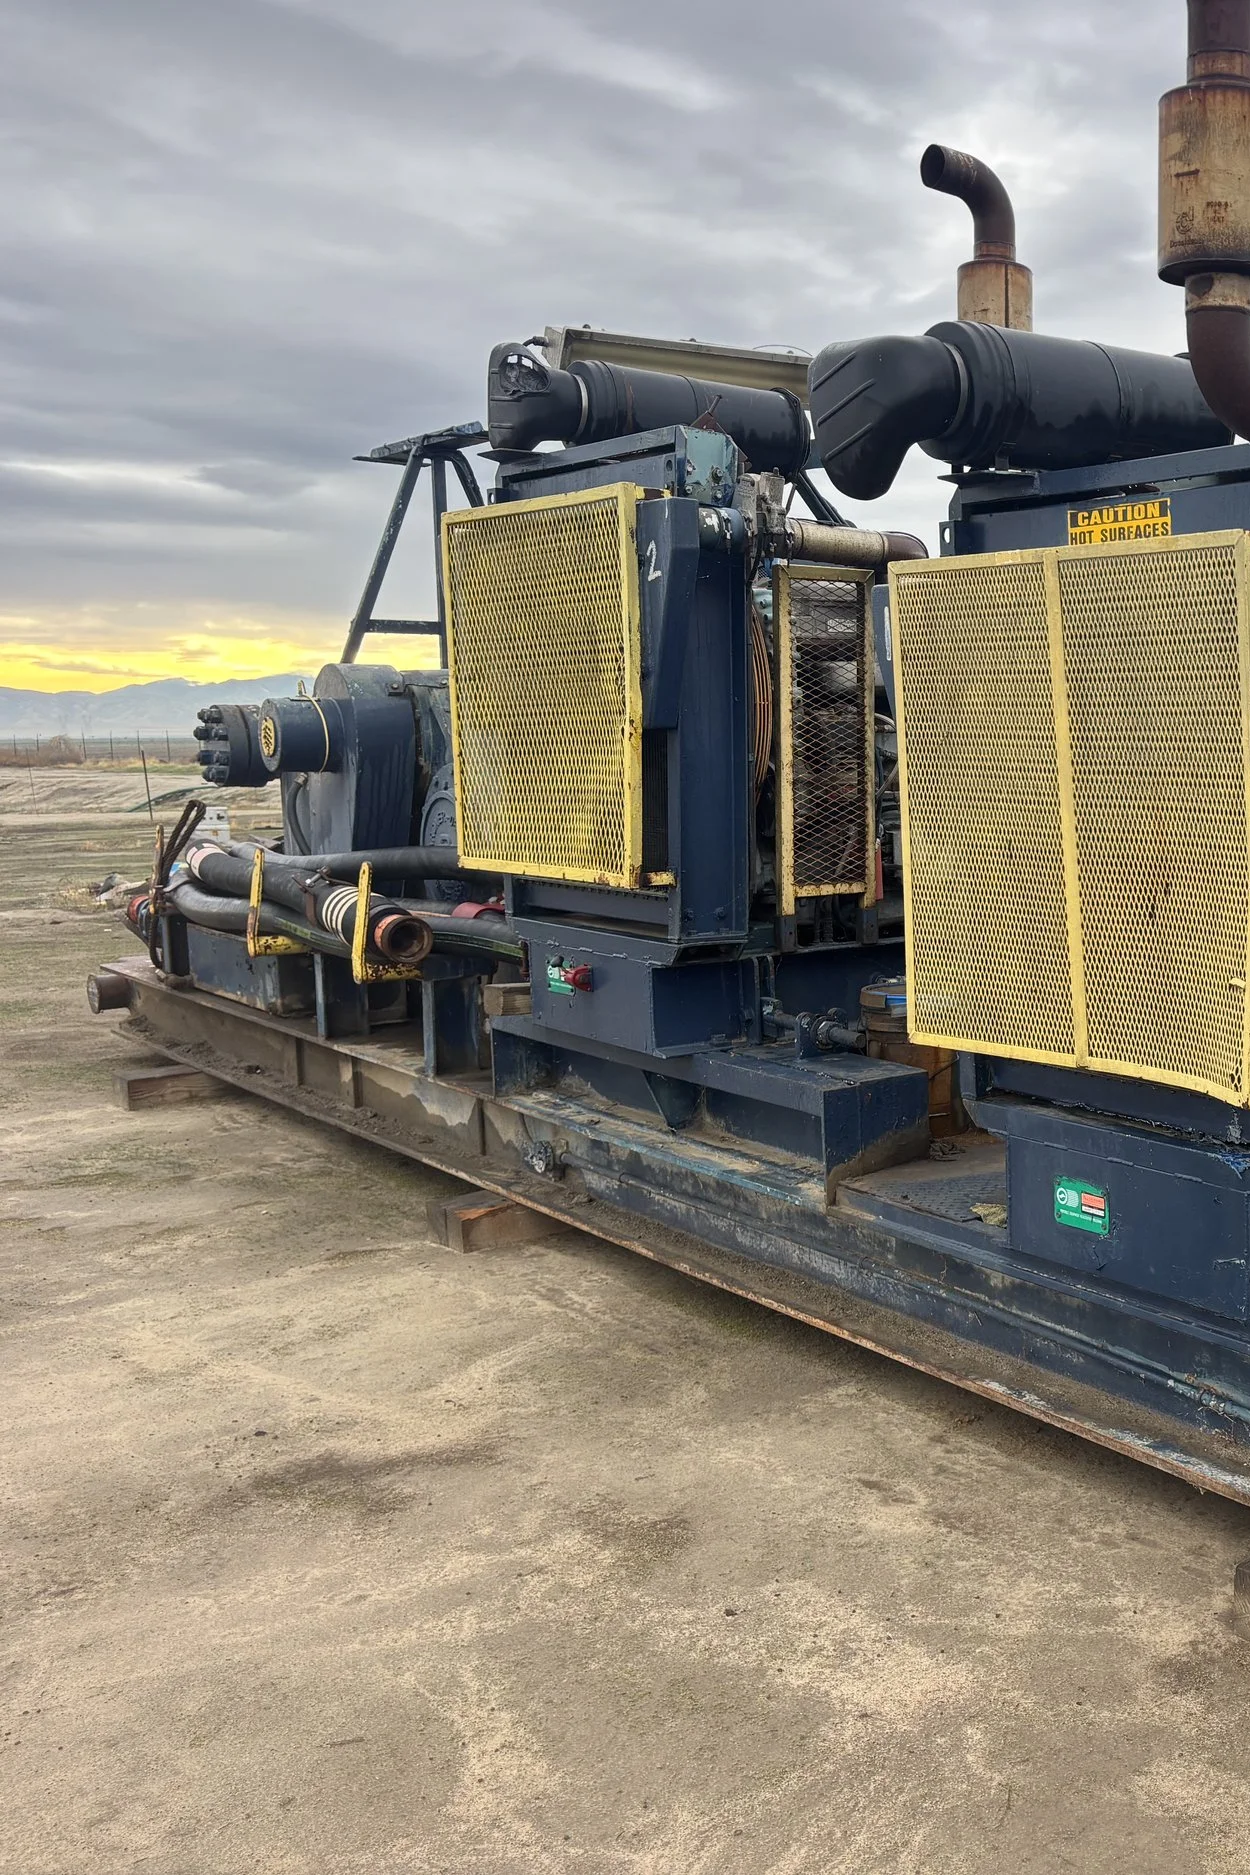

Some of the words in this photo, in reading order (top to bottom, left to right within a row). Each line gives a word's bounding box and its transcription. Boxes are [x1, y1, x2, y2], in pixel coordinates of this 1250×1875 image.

[1077, 502, 1160, 527] CAUTION
[1070, 530, 1094, 545] HOT
[1100, 522, 1169, 542] SURFACES
[646, 540, 662, 581] 2
